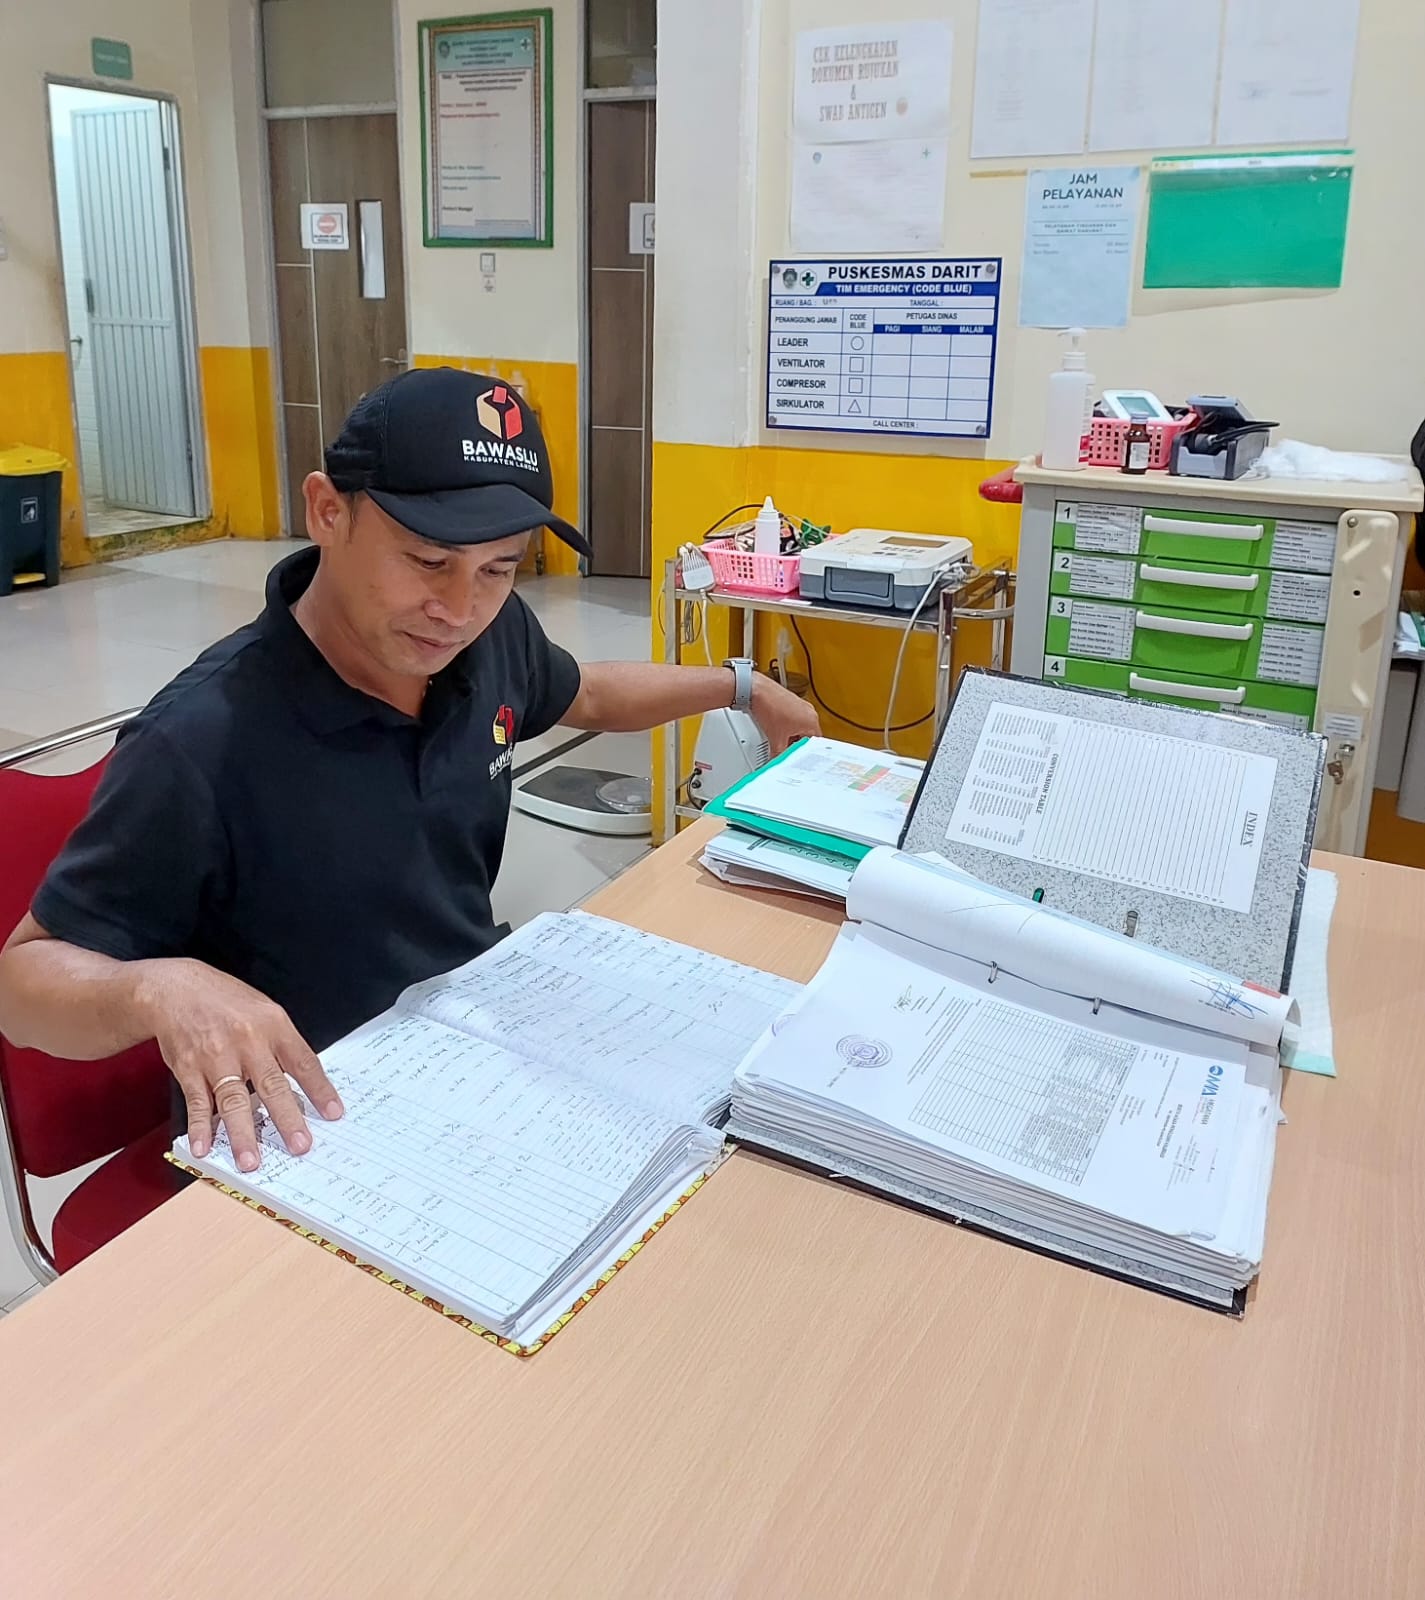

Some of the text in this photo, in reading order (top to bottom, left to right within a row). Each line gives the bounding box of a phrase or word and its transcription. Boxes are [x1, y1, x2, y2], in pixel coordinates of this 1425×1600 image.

[811, 61, 900, 84] DOKUMEN RUJUKAN
[847, 102, 888, 120] ANTIGEN
[1069, 173, 1098, 185] JAM
[1042, 187, 1124, 200] PELAYANAN
[828, 264, 982, 280] PUSKESMAS DARIT
[836, 284, 972, 294] TIM EMERGENCY (CODE BLUE)
[910, 299, 939, 307] TANGGAL
[775, 316, 837, 324] PENANGGUNG JAWAB
[849, 313, 867, 321] CODE
[937, 312, 957, 320] DINAS
[850, 321, 866, 329] BLUE
[885, 325, 900, 333] PAGI
[921, 325, 942, 333] SIANG
[777, 338, 809, 347] LEADER
[777, 359, 825, 369] VENTILATOR
[776, 379, 826, 389] COMPRESOR
[776, 399, 825, 409] SIRKULATOR
[873, 420, 889, 428] CALL
[890, 420, 915, 428] CENTER
[462, 440, 538, 467] BAWASLU
[464, 455, 514, 467] KABUPATEN
[1064, 506, 1071, 519] 1
[1061, 557, 1070, 569] 2
[1057, 601, 1066, 613] 3
[1051, 661, 1059, 672] 4
[1035, 752, 1059, 815] CONVERSION TABLE
[1241, 810, 1259, 847] INDEX
